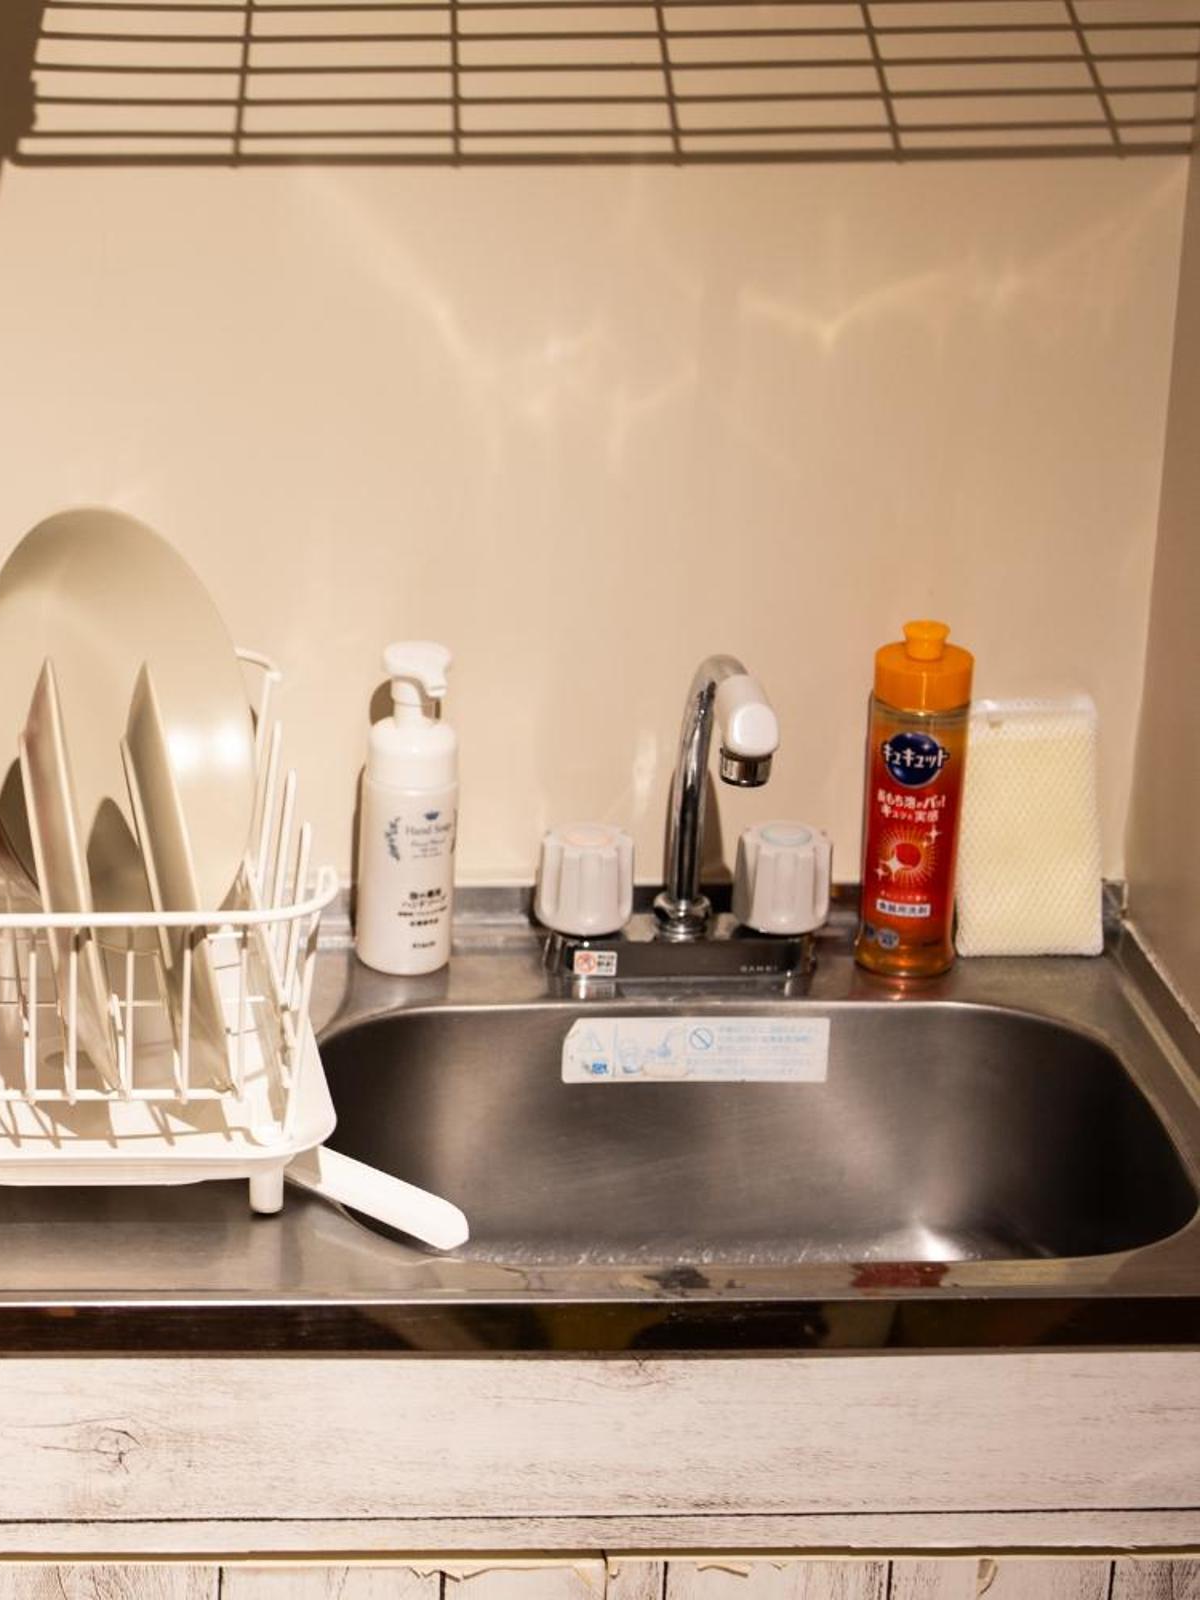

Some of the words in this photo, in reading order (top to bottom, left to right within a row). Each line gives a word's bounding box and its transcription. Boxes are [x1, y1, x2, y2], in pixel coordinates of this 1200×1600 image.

[883, 743, 948, 768] キュキュット
